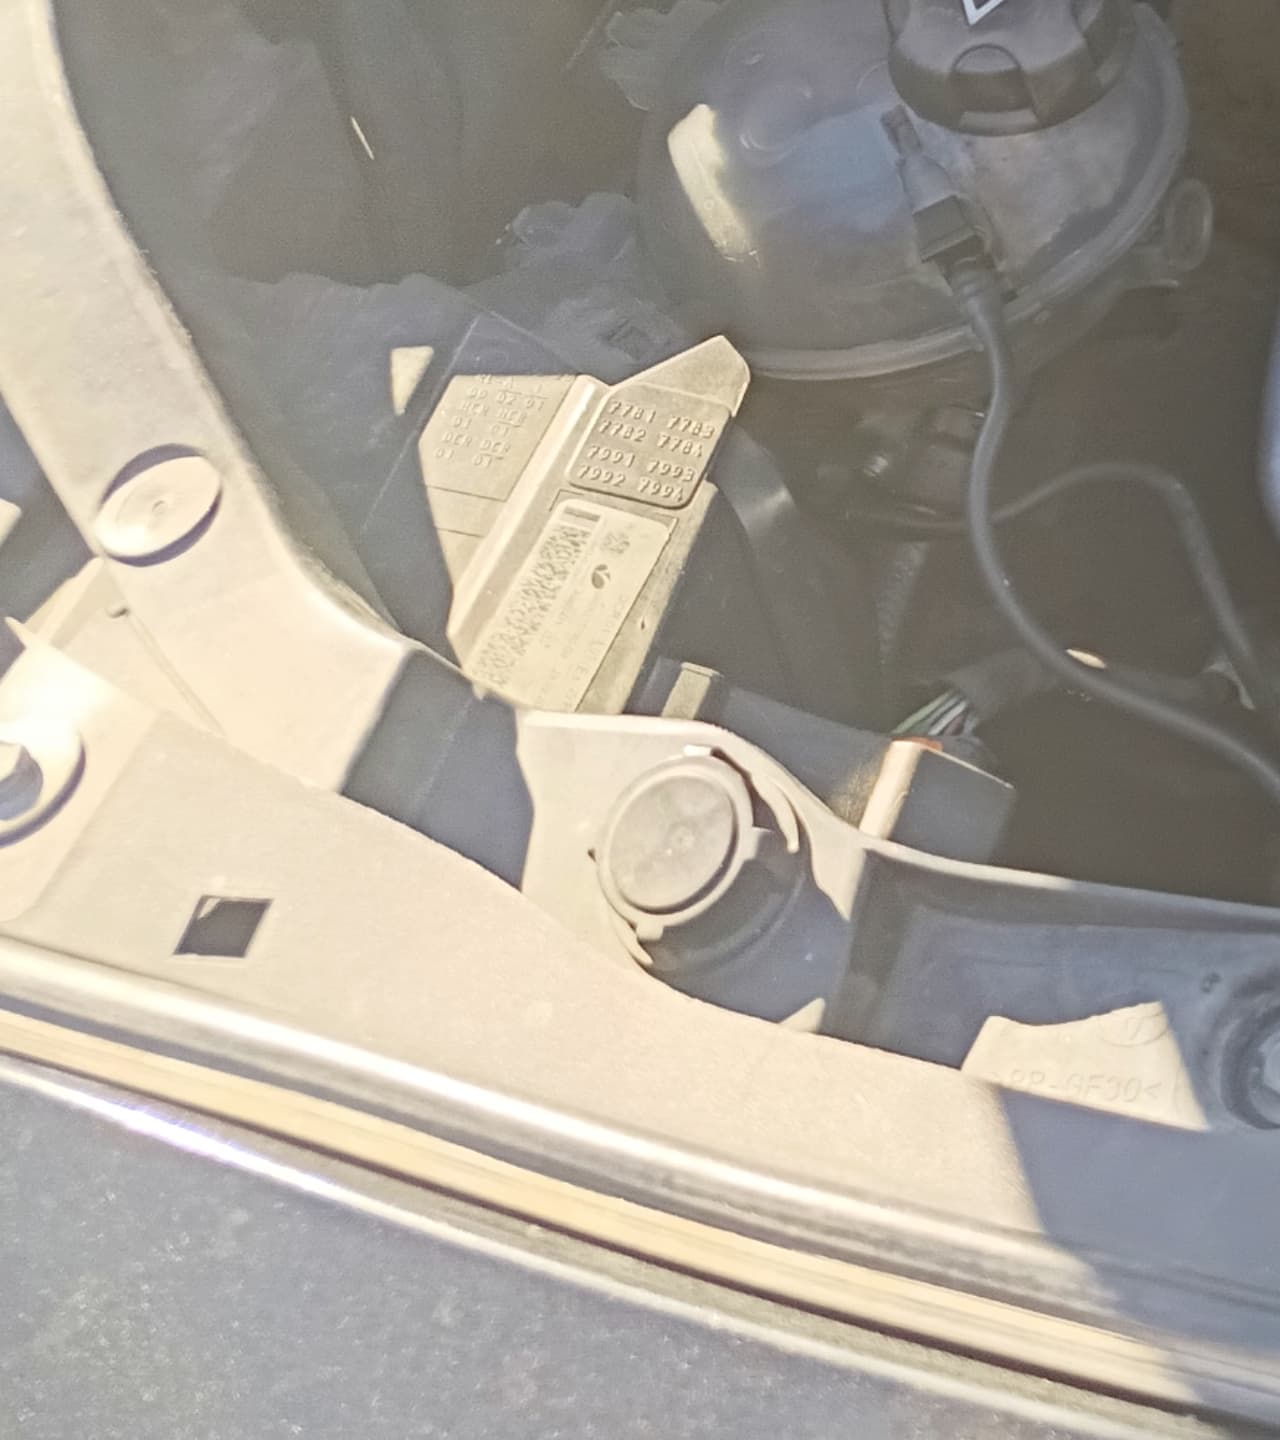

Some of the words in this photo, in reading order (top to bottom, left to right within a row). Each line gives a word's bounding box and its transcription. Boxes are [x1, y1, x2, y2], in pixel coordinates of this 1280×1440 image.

[599, 419, 647, 442] 7782
[608, 401, 657, 424] 7781
[667, 415, 716, 439] 7783
[577, 464, 627, 488] 7992
[586, 444, 636, 468] 7991
[647, 460, 696, 483] 7993
